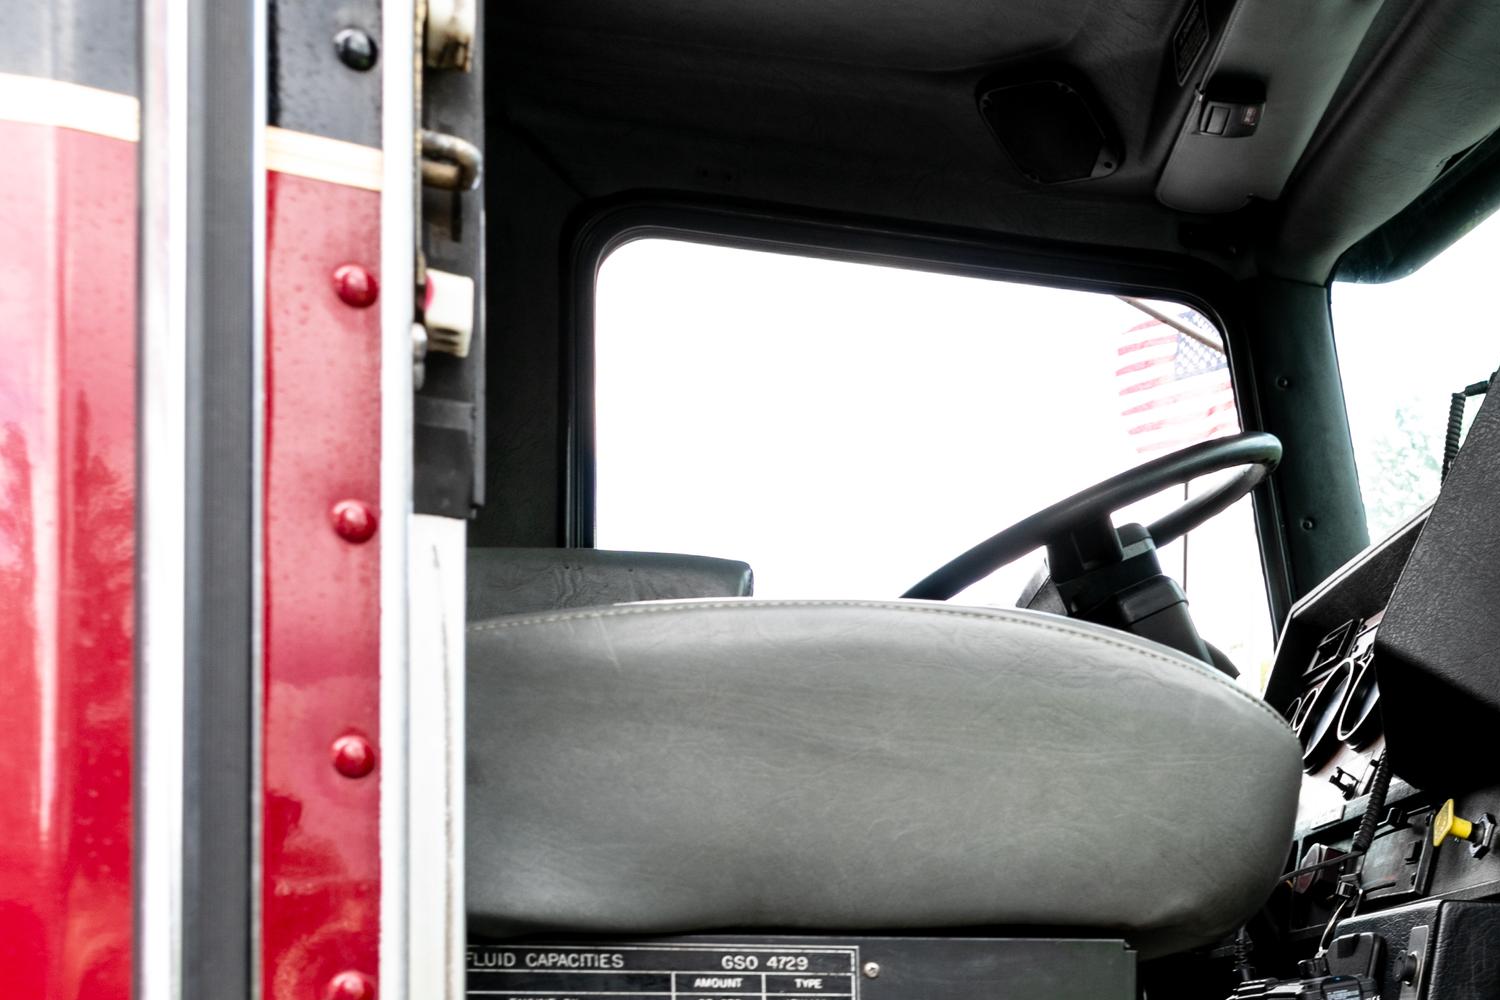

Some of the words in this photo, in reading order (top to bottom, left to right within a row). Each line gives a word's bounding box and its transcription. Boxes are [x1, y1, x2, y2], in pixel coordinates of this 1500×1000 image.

[525, 953, 624, 968] CAPACITIES
[721, 955, 758, 970] GSO
[766, 956, 809, 971] 4729
[694, 977, 744, 988] AMOUNT
[794, 978, 823, 989] TYPE
